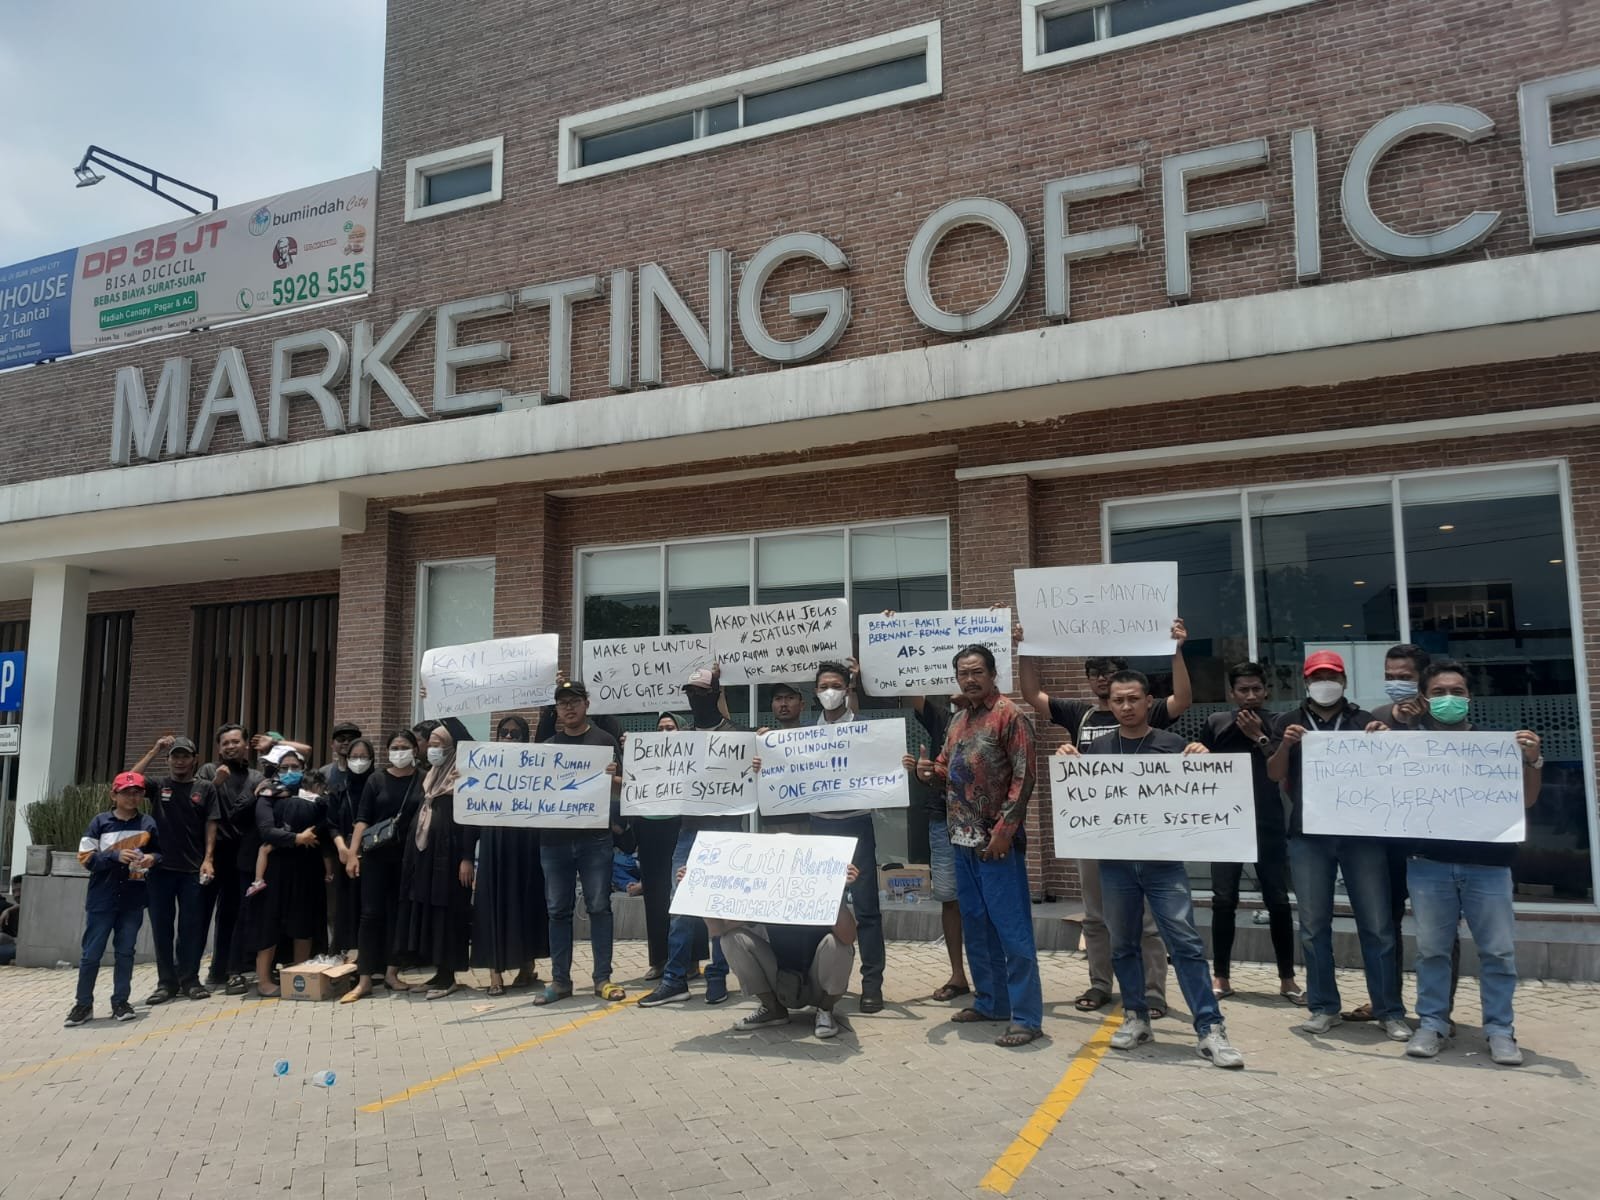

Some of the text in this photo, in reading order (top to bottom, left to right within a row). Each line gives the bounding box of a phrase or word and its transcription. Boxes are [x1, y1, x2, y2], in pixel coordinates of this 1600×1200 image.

[272, 197, 345, 228] bumiindah
[82, 220, 227, 279] DP 35 JT
[105, 258, 196, 291] BISA DICICIL
[110, 67, 1600, 467] MARKETING OFFICE
[93, 271, 208, 308] BEBAS BIAYA SURAT-SURAT
[272, 272, 321, 307] 5928
[327, 262, 365, 295] 555
[2, 304, 50, 329] 2 Lantai
[100, 308, 126, 325] Hadiah
[154, 298, 174, 315] Pagar
[174, 297, 182, 308] &
[182, 295, 193, 307] AC
[11, 327, 33, 340] Tidur
[1034, 586, 1079, 609] ABS
[1100, 583, 1169, 603] MANTAN
[713, 604, 839, 632] AKAD NIKAH JELAS
[954, 616, 968, 625] KE
[970, 616, 997, 626] HULU
[1052, 618, 1160, 637] INGKAR JANJI
[957, 625, 1004, 636] KEMUDIAN
[593, 637, 708, 659] MAKE UP LUNTUR
[775, 646, 785, 658] DI
[811, 640, 838, 654] INDAH
[897, 645, 926, 659] ABS
[631, 660, 672, 678] DEMI
[743, 664, 766, 679] KOK
[898, 667, 920, 676] KAMI
[1, 660, 15, 703] P
[635, 683, 664, 699] GATE
[930, 676, 957, 685] SYSTE
[763, 724, 869, 749] CUSTOMER BUTUH
[467, 748, 591, 770] KAMI BELI RUMAH
[633, 735, 747, 761] BERIKAN KAMI
[785, 740, 851, 757] DILINDUNGI
[1325, 738, 1519, 760] KATANYA BAHAGIA
[666, 759, 697, 776] HAK
[761, 765, 786, 778] BUKAN
[1056, 759, 1233, 783] JANGAN JUAL RUMAH
[1306, 759, 1520, 782] TINGGAL DI BUMI INDAH
[484, 772, 556, 793] CLUSTER
[811, 779, 843, 793] GATE
[1066, 781, 1221, 803] KLO GAK AMANAH
[466, 797, 503, 813] BUKAN
[511, 797, 533, 813] BELI
[537, 798, 557, 813] KUE
[1335, 785, 1519, 811] KOK KERAMPOKAN
[1113, 813, 1149, 827] GATE
[728, 842, 786, 874] Cuti
[769, 875, 818, 899] ABS
[783, 896, 841, 922] DRAMA
